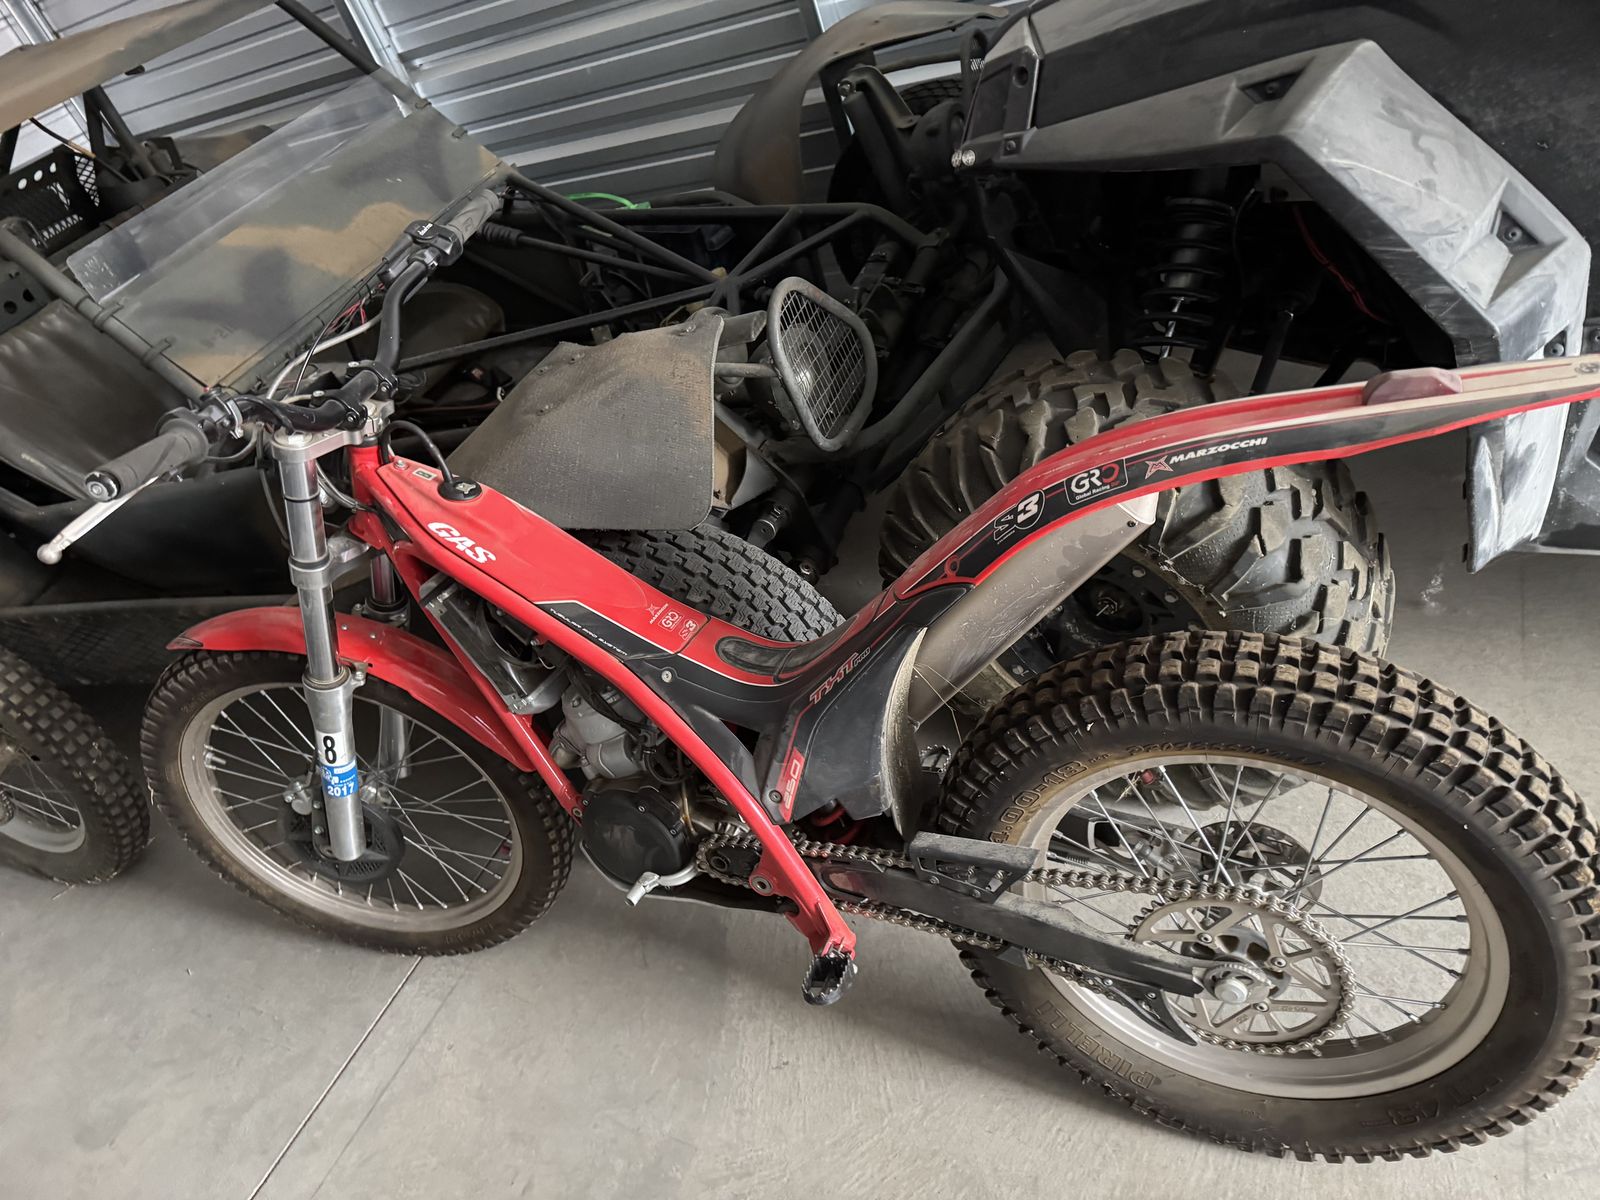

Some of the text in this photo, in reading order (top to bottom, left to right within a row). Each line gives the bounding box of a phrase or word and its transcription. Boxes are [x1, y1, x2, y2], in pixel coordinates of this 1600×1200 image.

[1169, 436, 1269, 465] MARZOCCHI
[1070, 463, 1120, 494] GRO
[427, 522, 497, 564] GAS
[323, 735, 337, 764] 8
[327, 782, 355, 797] 2017
[784, 758, 801, 810] 250
[1036, 1000, 1156, 1089] PIRELLI
